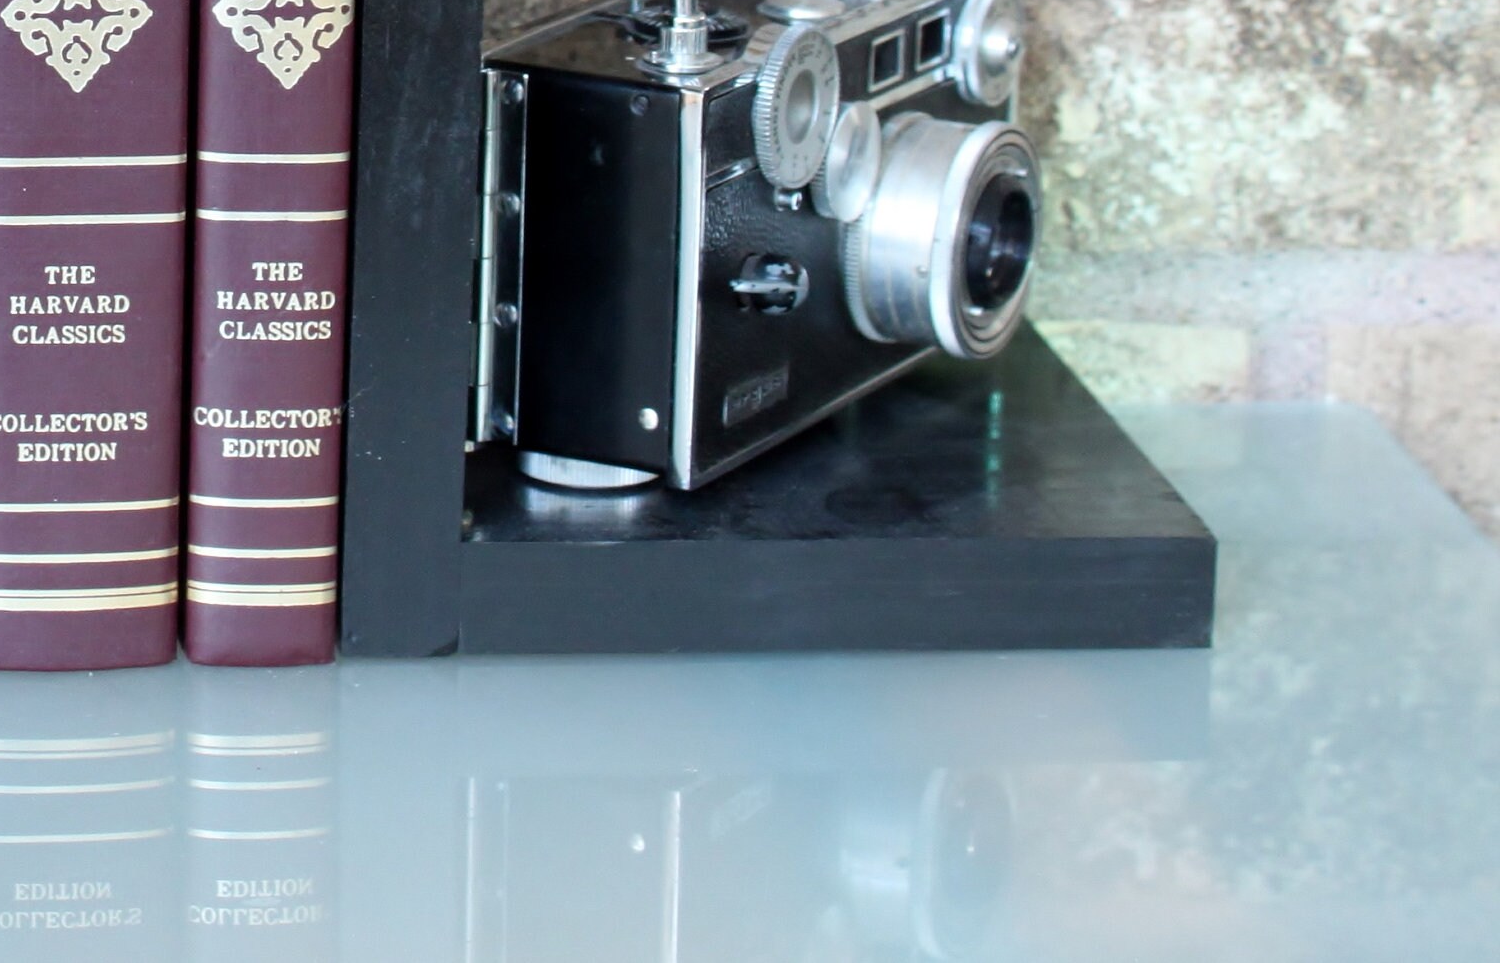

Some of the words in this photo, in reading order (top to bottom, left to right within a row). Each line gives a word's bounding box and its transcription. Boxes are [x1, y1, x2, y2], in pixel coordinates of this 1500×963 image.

[43, 265, 96, 285] THE
[251, 261, 304, 282] THE
[9, 294, 131, 315] HARVARD
[216, 291, 336, 311] HARVARD
[11, 323, 126, 345] CLASSICS
[218, 320, 332, 341] CLASSICS
[16, 441, 118, 463] EDITION
[221, 438, 322, 459] EDITION
